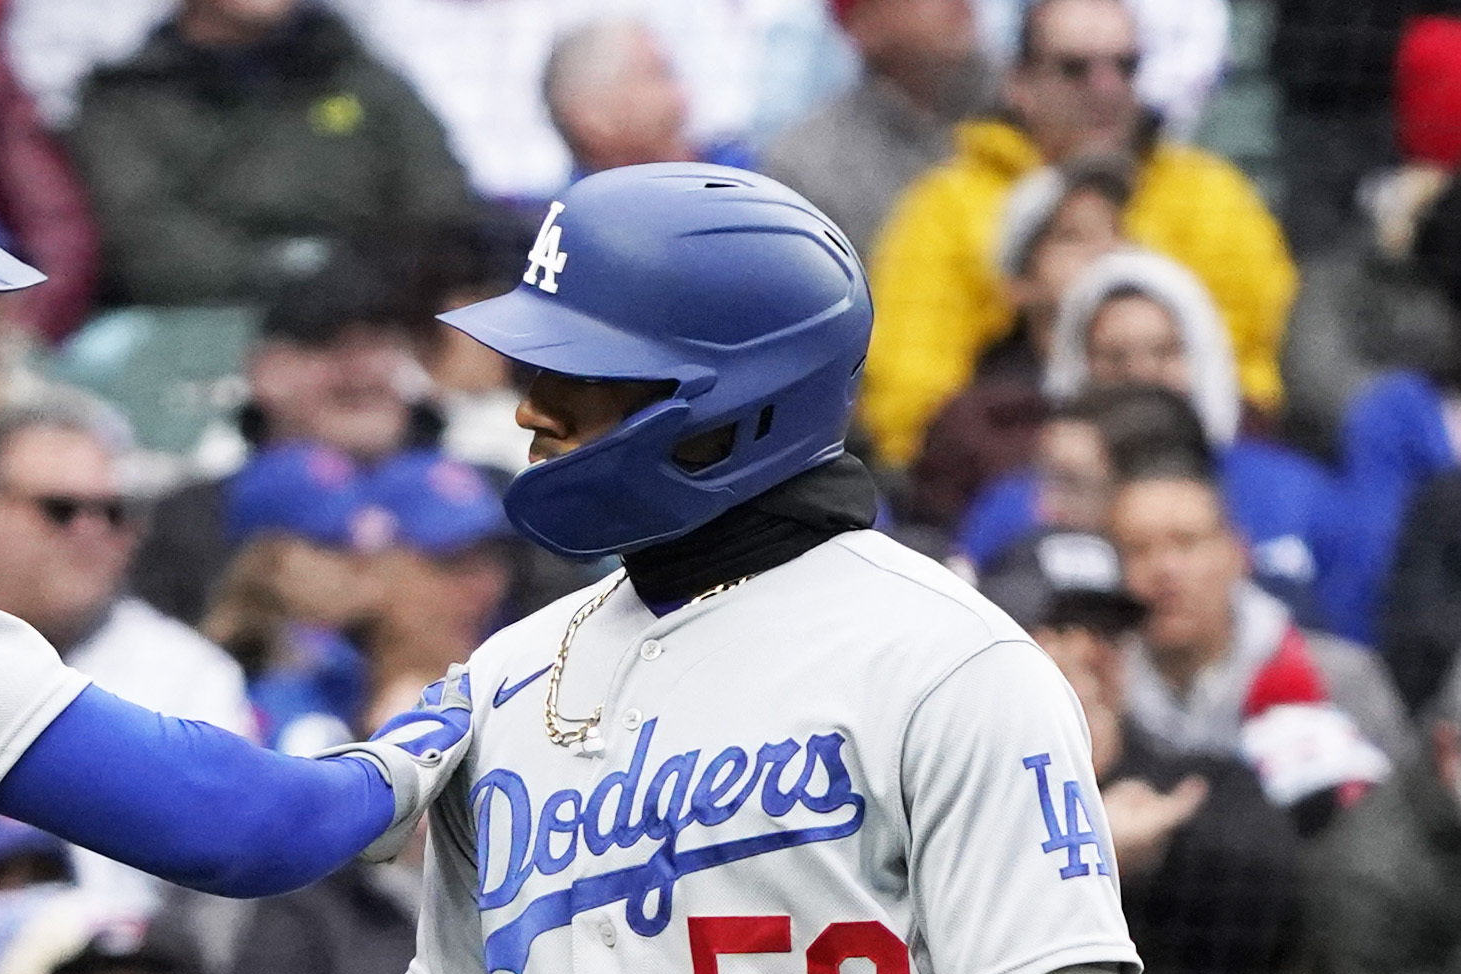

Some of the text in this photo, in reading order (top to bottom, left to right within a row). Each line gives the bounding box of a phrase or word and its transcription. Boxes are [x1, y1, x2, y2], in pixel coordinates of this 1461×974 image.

[523, 201, 568, 294] LA
[470, 716, 865, 937] Dodgers
[1022, 753, 1111, 880] LA
